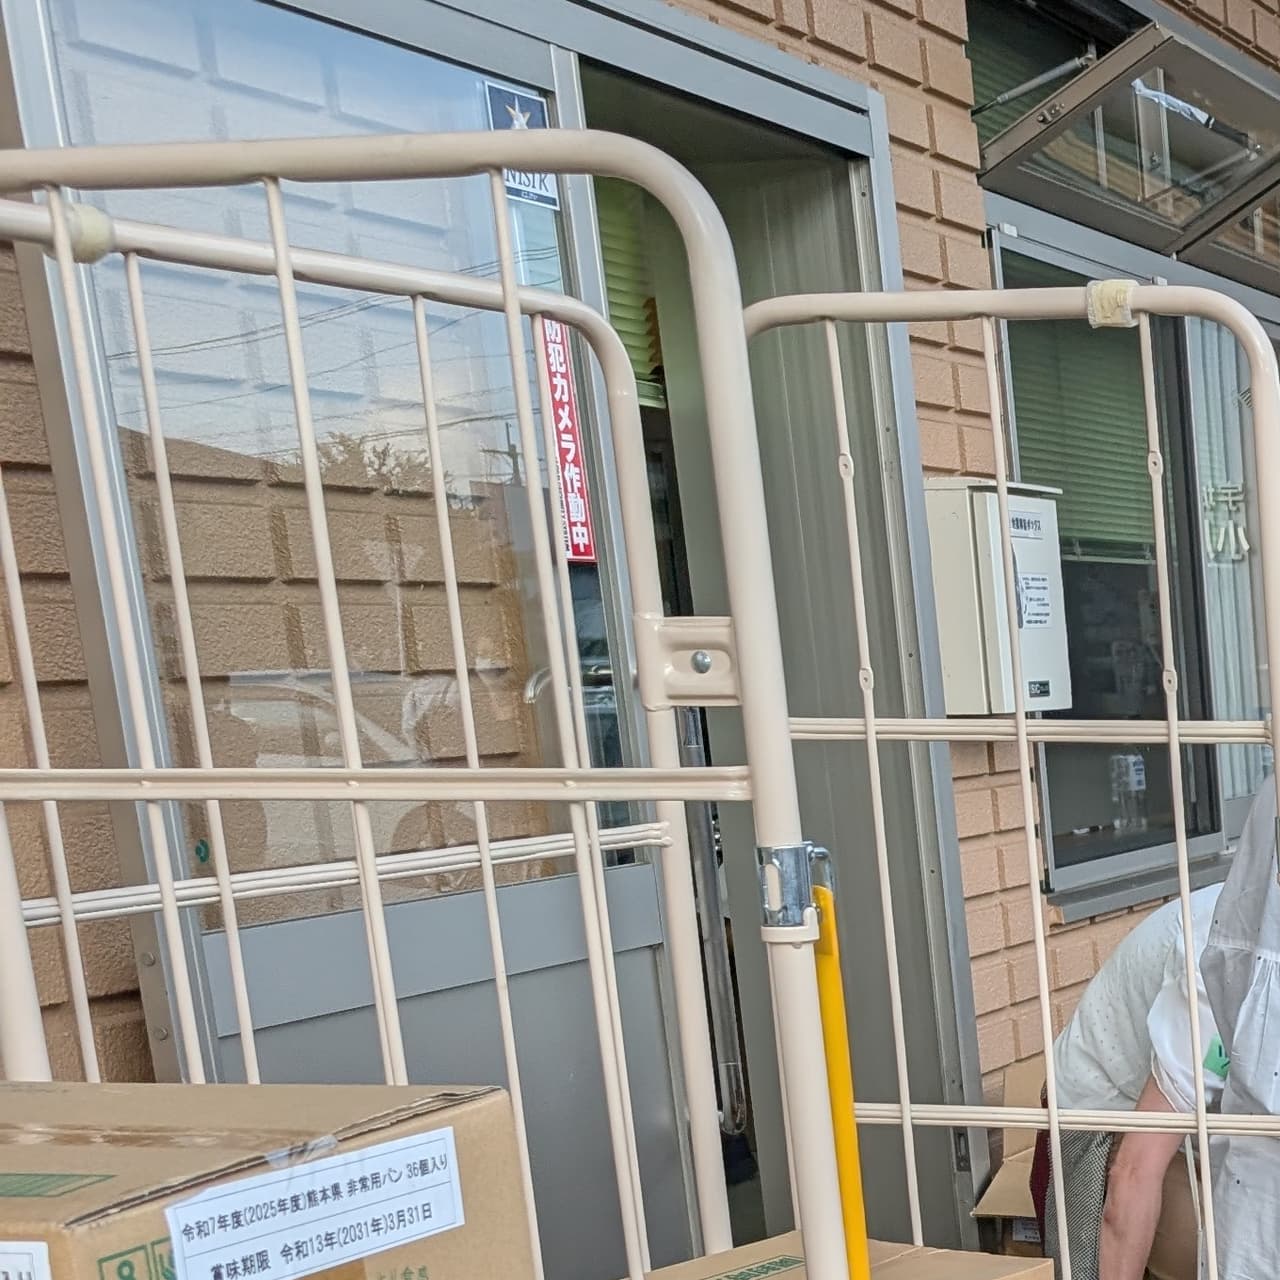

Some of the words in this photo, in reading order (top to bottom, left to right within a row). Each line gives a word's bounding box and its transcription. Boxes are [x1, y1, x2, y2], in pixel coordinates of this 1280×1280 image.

[181, 1180, 344, 1243] 令和7年度(2025年度)熊本県
[347, 1168, 404, 1198] 非常用パン
[406, 1153, 449, 1181] 36個入り
[279, 1203, 434, 1266] 令和13年(2031年)3月31日
